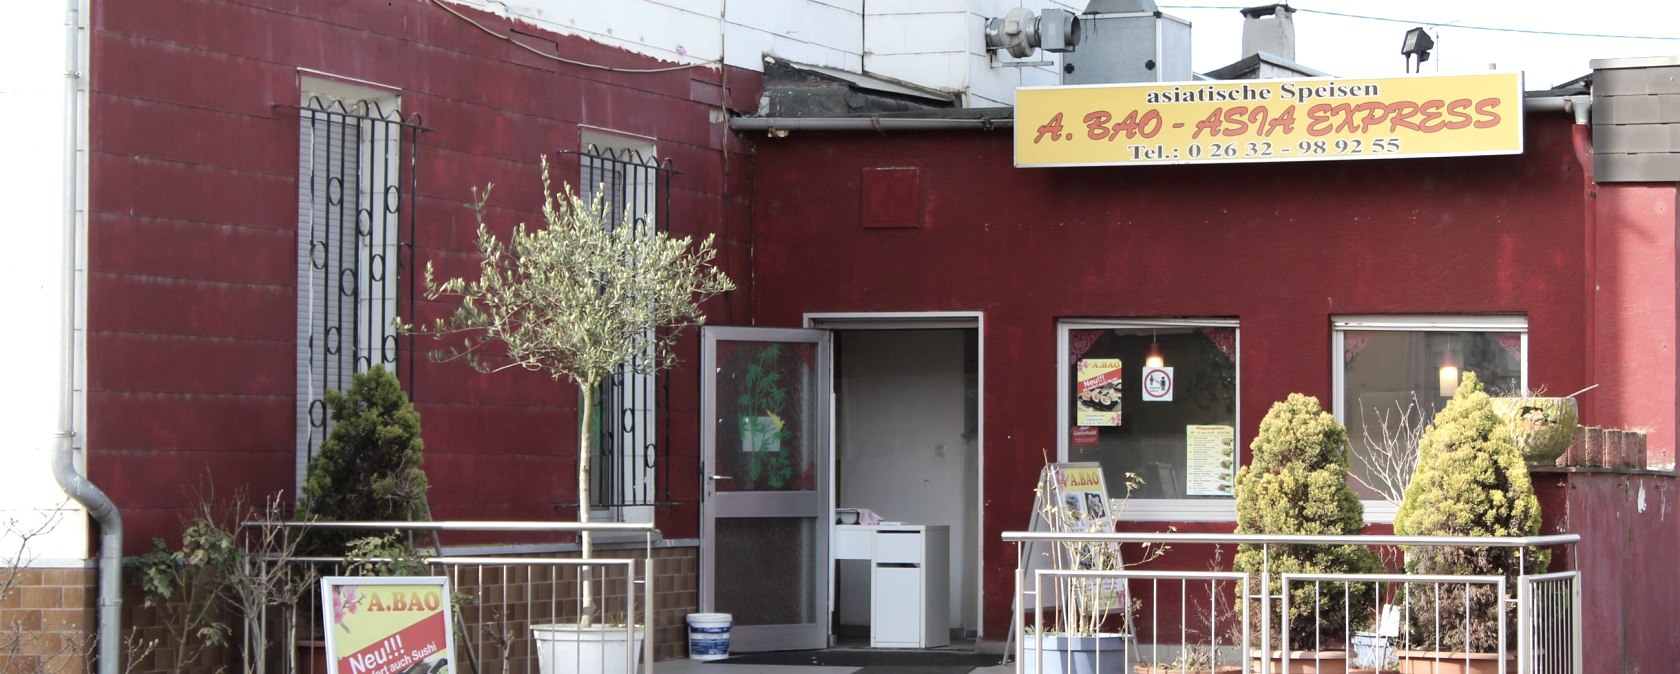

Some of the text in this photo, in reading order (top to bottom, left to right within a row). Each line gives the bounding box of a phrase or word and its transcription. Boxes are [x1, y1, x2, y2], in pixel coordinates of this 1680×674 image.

[1147, 82, 1378, 103] asiatische Speisen
[1033, 112, 1073, 144] A.
[1083, 109, 1163, 141] BAO
[1192, 104, 1296, 139] ASIA
[1306, 97, 1501, 137] EXPRESS
[1128, 145, 1178, 159] Tel.:
[1188, 143, 1201, 158] 0
[1210, 142, 1237, 157] 26
[1245, 142, 1272, 156] 32
[1299, 140, 1326, 155] 98
[1335, 139, 1362, 153] 92
[1372, 138, 1400, 153] 55
[1071, 472, 1099, 486] A.BAO
[367, 591, 440, 611] A.BAO
[349, 634, 405, 674] Neu!!!
[389, 655, 412, 672] auch
[411, 641, 437, 661] Sushi
